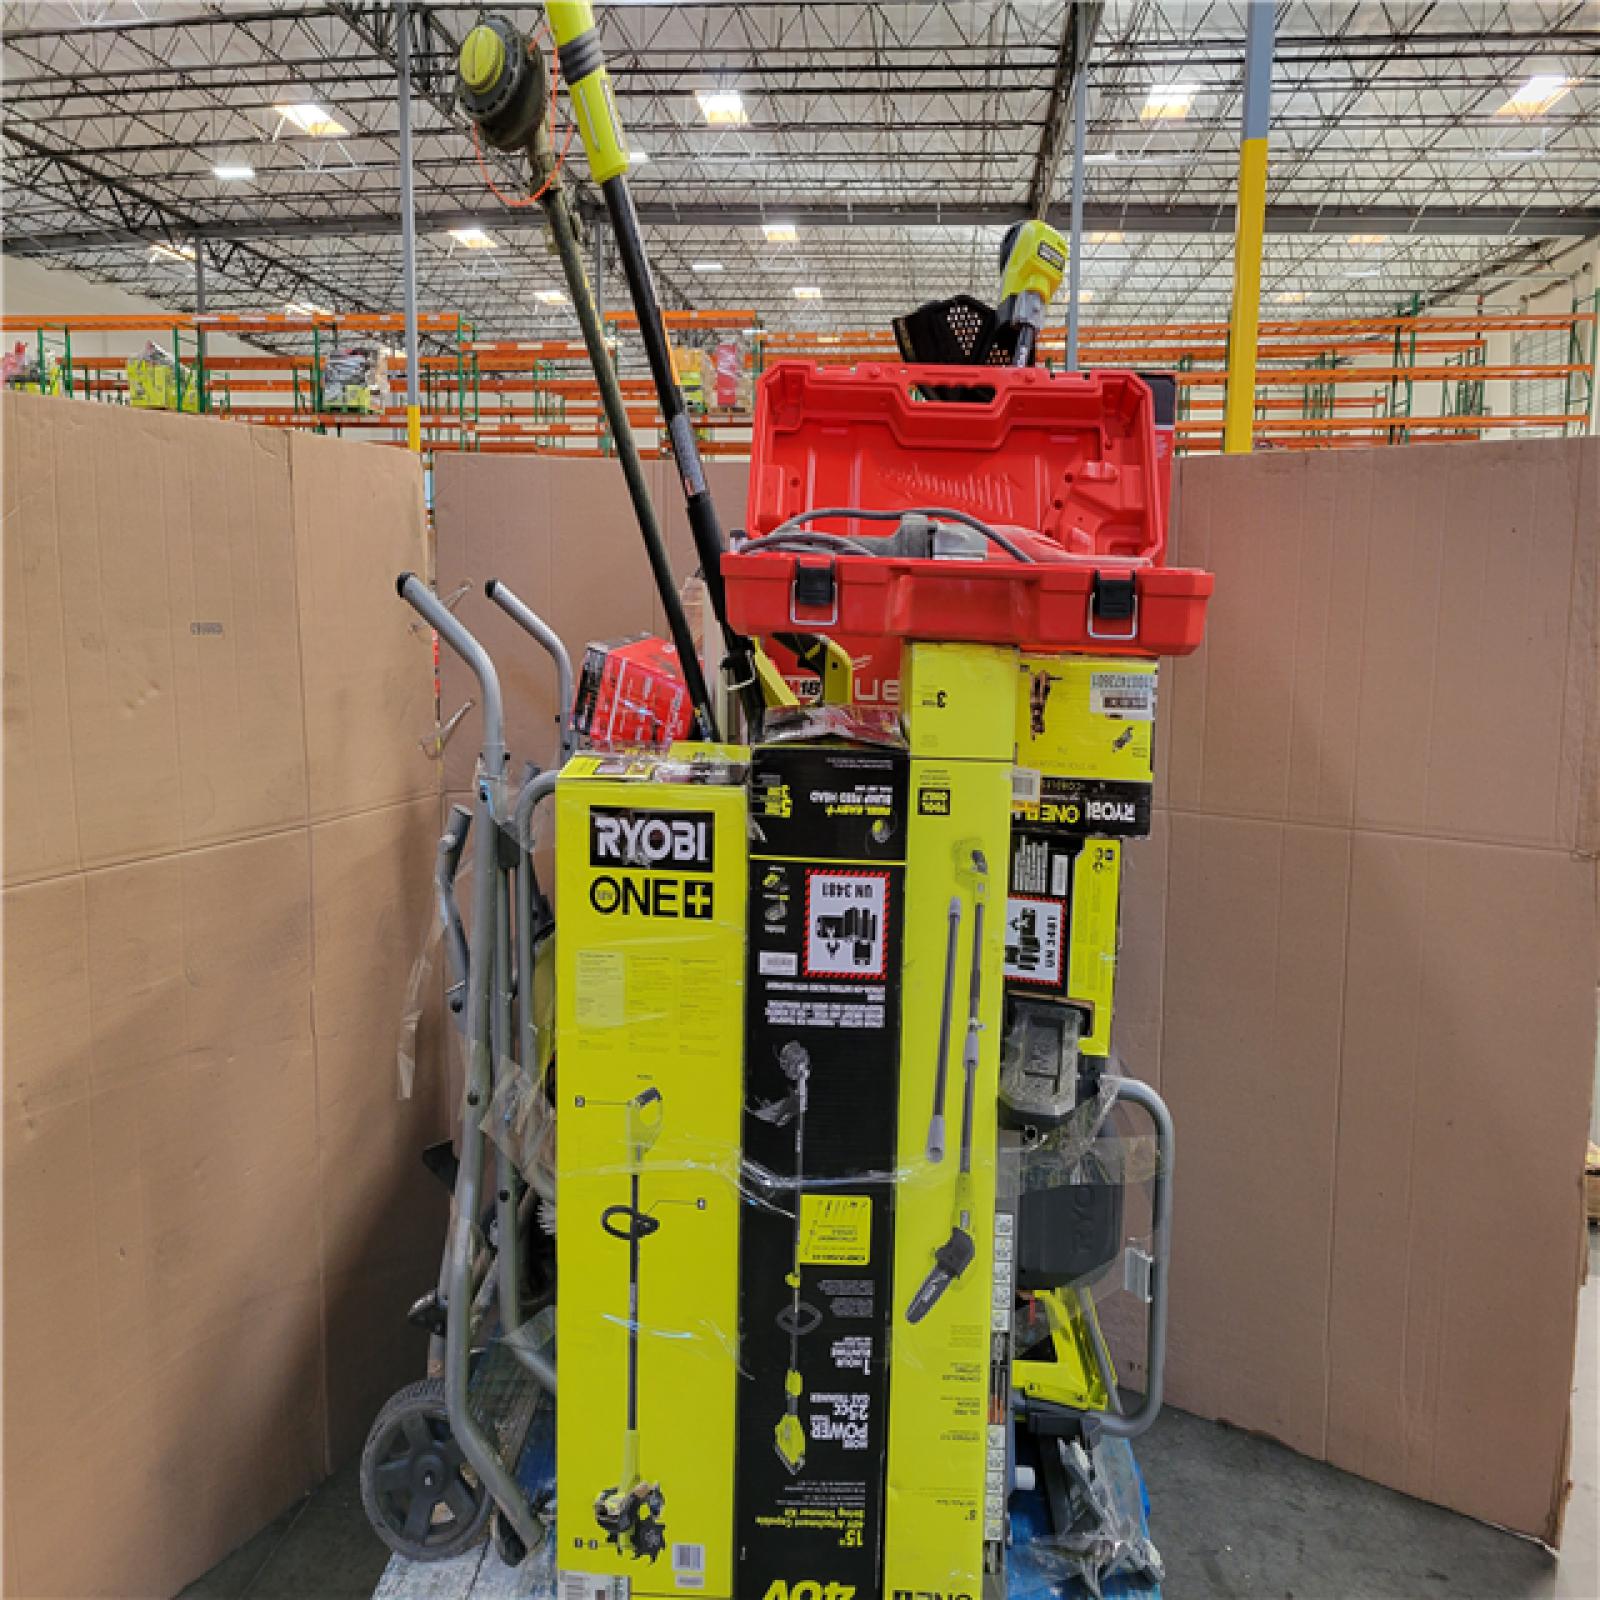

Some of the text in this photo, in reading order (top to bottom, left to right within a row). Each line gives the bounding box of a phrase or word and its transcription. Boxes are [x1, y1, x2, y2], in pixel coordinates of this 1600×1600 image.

[854, 678, 899, 701] UE
[809, 790, 838, 803] HEAD
[1085, 801, 1136, 823] RYOBI
[594, 817, 708, 861] RYOBI
[589, 875, 714, 918] ONE+
[822, 883, 874, 898] UN 3481
[1045, 915, 1057, 968] UN 3481
[863, 1358, 871, 1375] 1
[810, 1422, 868, 1440] POWER
[839, 1528, 864, 1547] 15"
